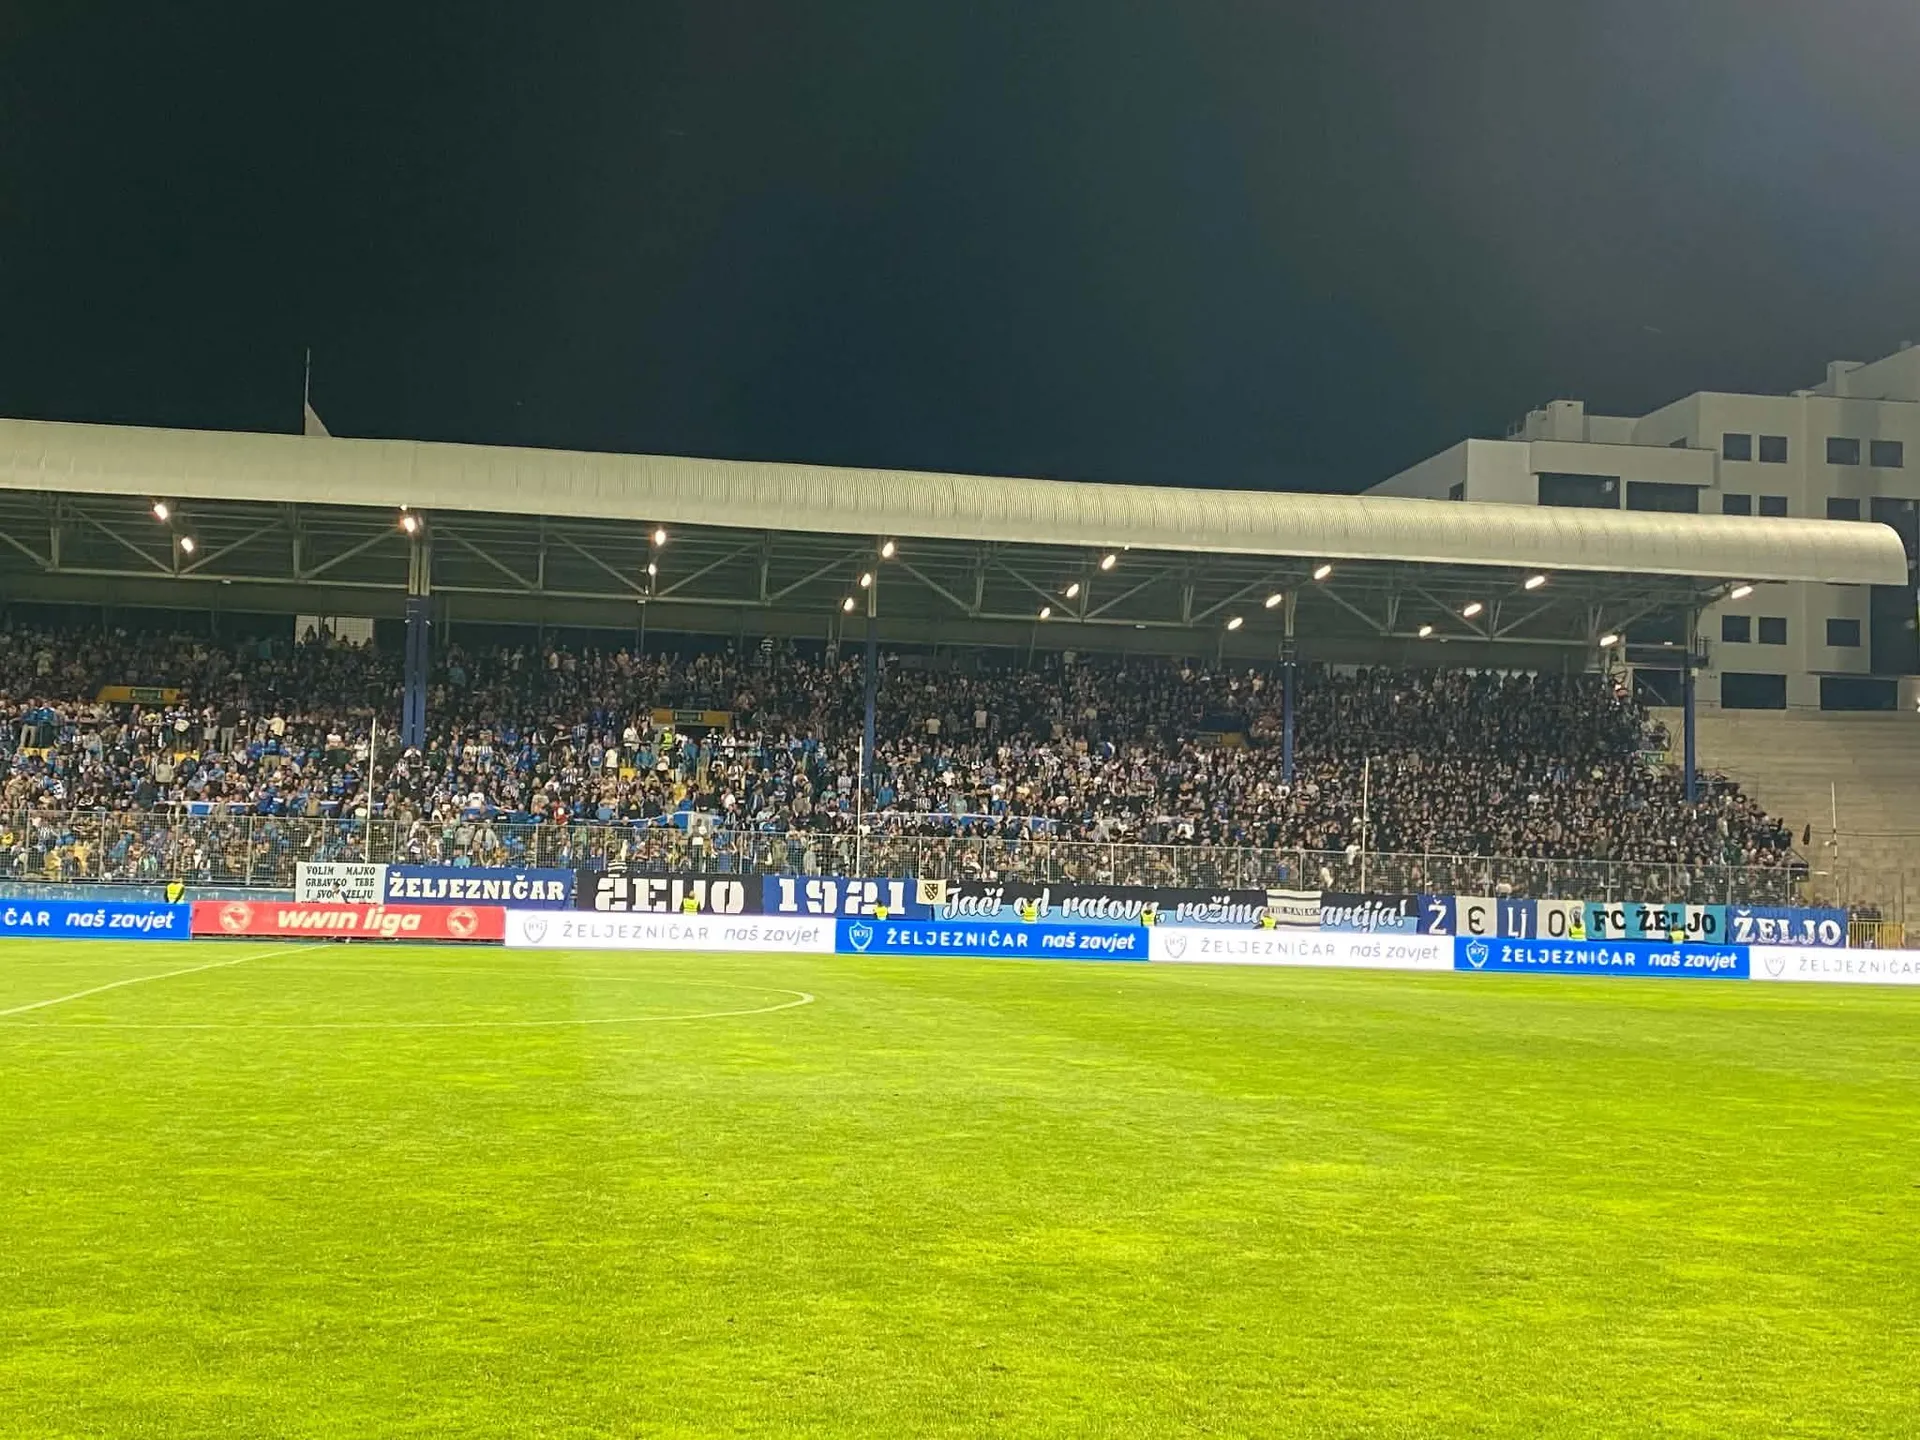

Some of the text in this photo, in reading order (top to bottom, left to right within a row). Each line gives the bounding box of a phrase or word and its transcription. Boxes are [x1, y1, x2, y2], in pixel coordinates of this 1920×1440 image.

[306, 866, 375, 875] VOLIM MAJKO
[355, 878, 374, 887] TEBE
[306, 890, 310, 898] I
[389, 871, 564, 900] ŽELJEZNIČAR
[779, 878, 904, 915] 1921
[0, 908, 175, 932] ČAR naš zavjet
[363, 906, 421, 936] liga
[943, 887, 1004, 919] Jači
[1320, 900, 1407, 933] artija!
[1593, 906, 1716, 934] FC ŽELJO
[563, 921, 820, 945] ŽELJEZNIČAR naš zavjet
[1734, 909, 1841, 945] ŽELJO
[887, 928, 1028, 948] ŽELJEZNIČAR
[1043, 931, 1075, 949] naš
[1080, 933, 1135, 954] zavjet
[1200, 936, 1440, 963] ŽELJEZNIČAR naš zavjet
[1502, 945, 1635, 966] ŽELJEZNIČAR
[1649, 948, 1680, 967] naš
[1684, 951, 1737, 971] zavjet
